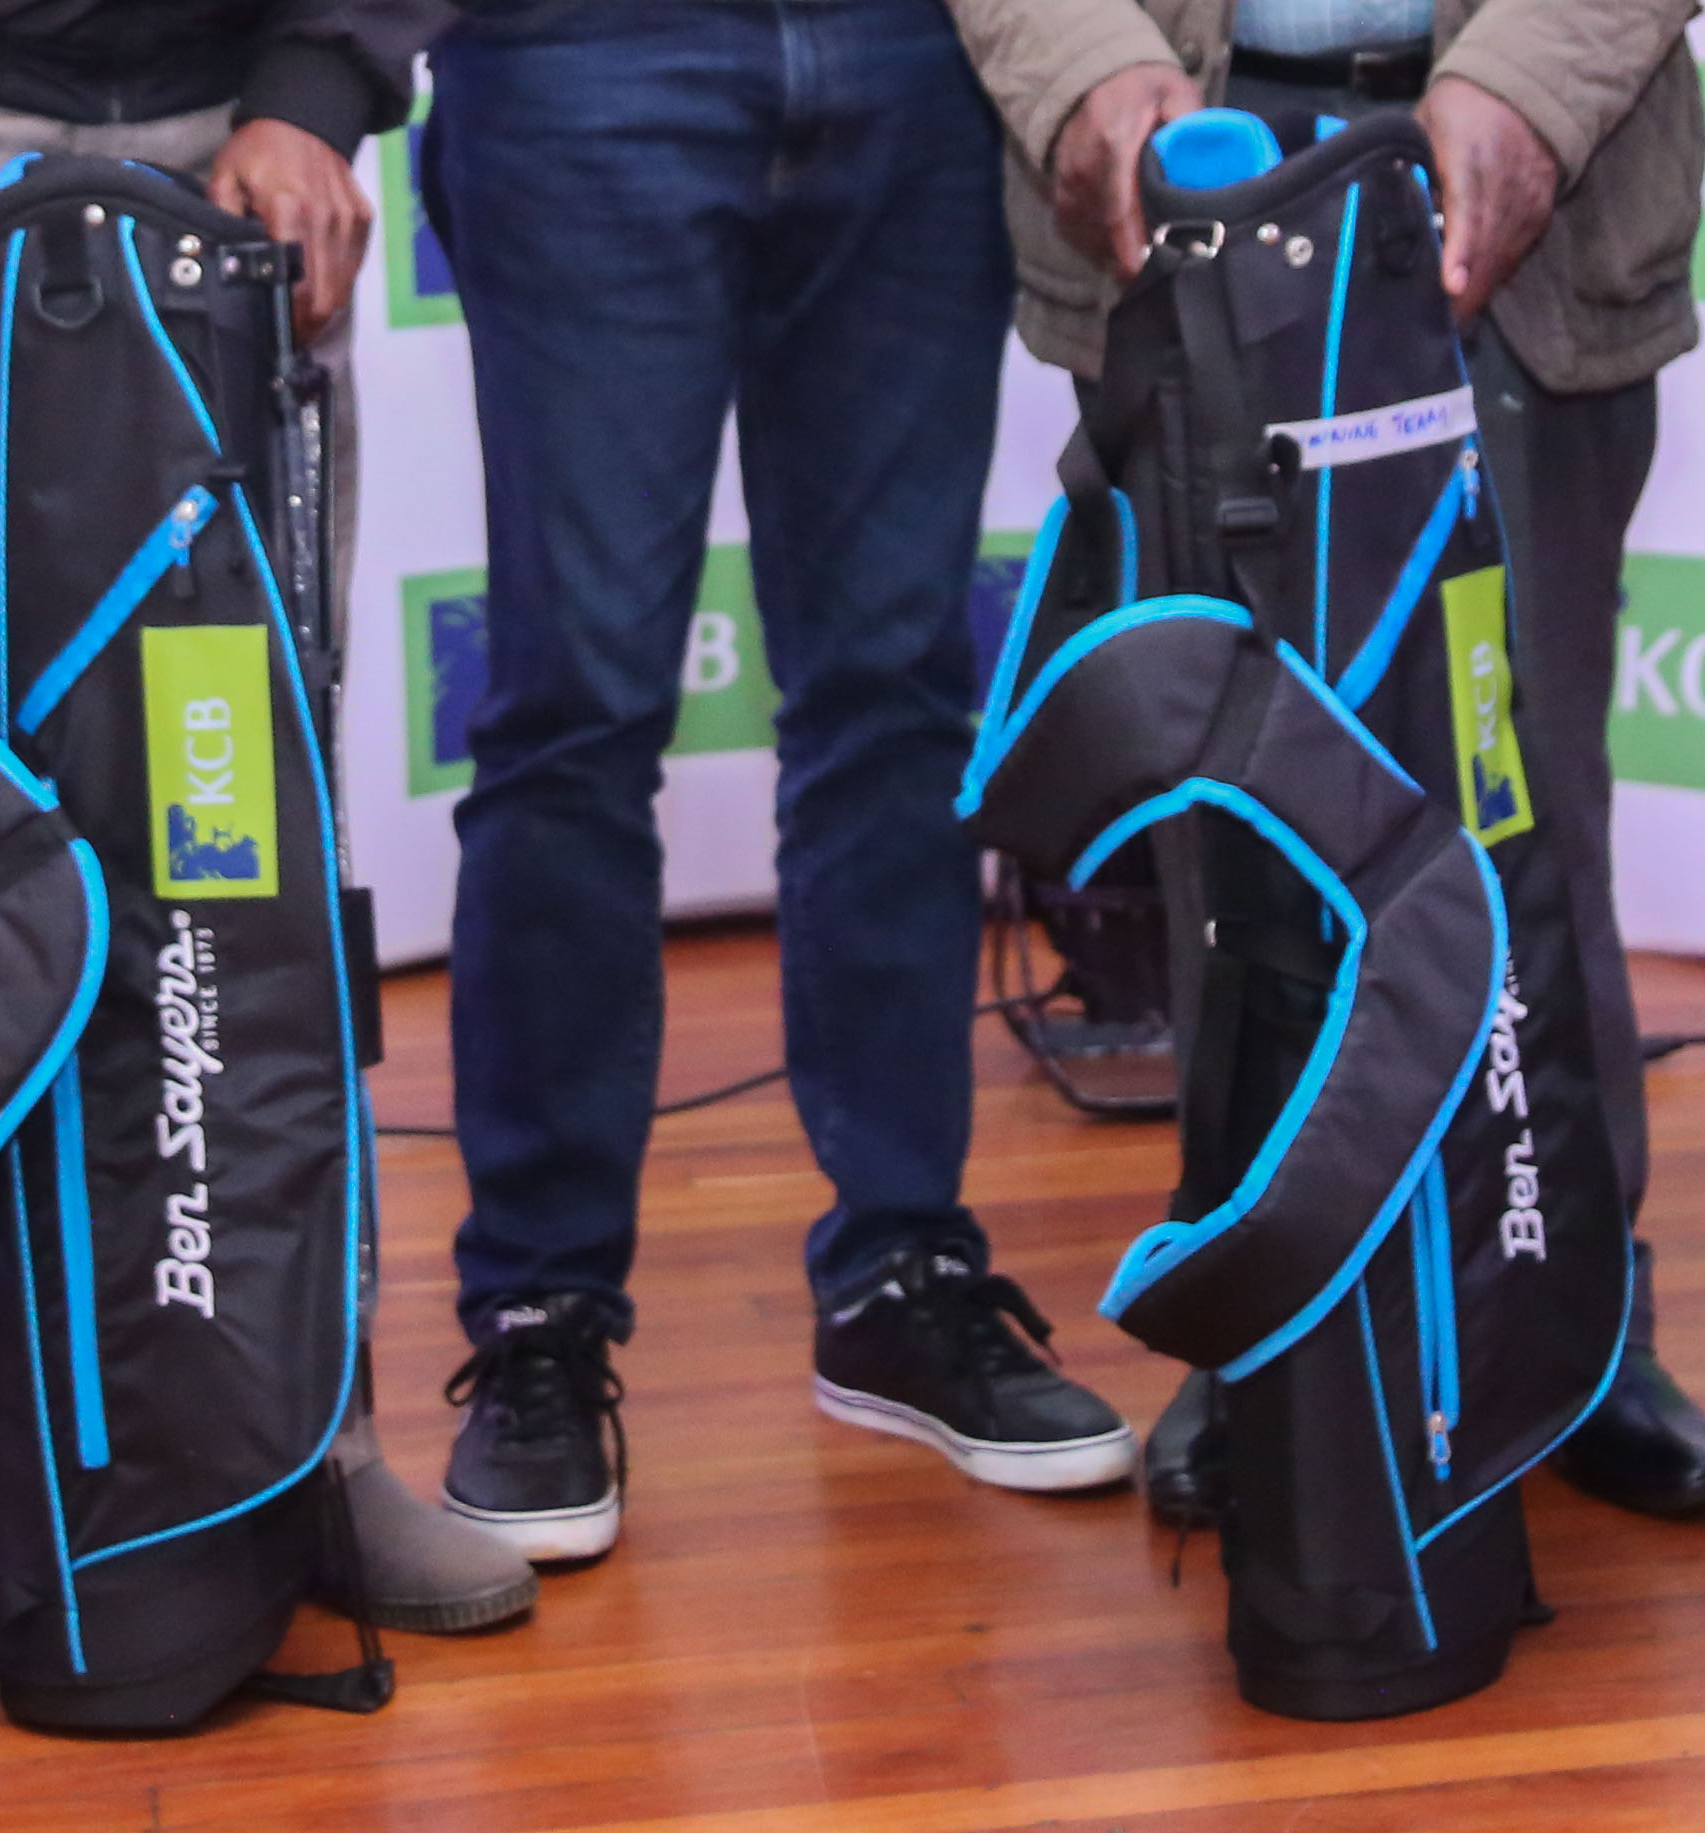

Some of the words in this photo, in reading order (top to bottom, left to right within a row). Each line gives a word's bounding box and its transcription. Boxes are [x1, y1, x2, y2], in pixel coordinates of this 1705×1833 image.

[184, 696, 234, 806] KCB
[198, 984, 220, 1052] SINCE
[1499, 1128, 1547, 1255] Ben
[156, 1185, 216, 1319] Ben
